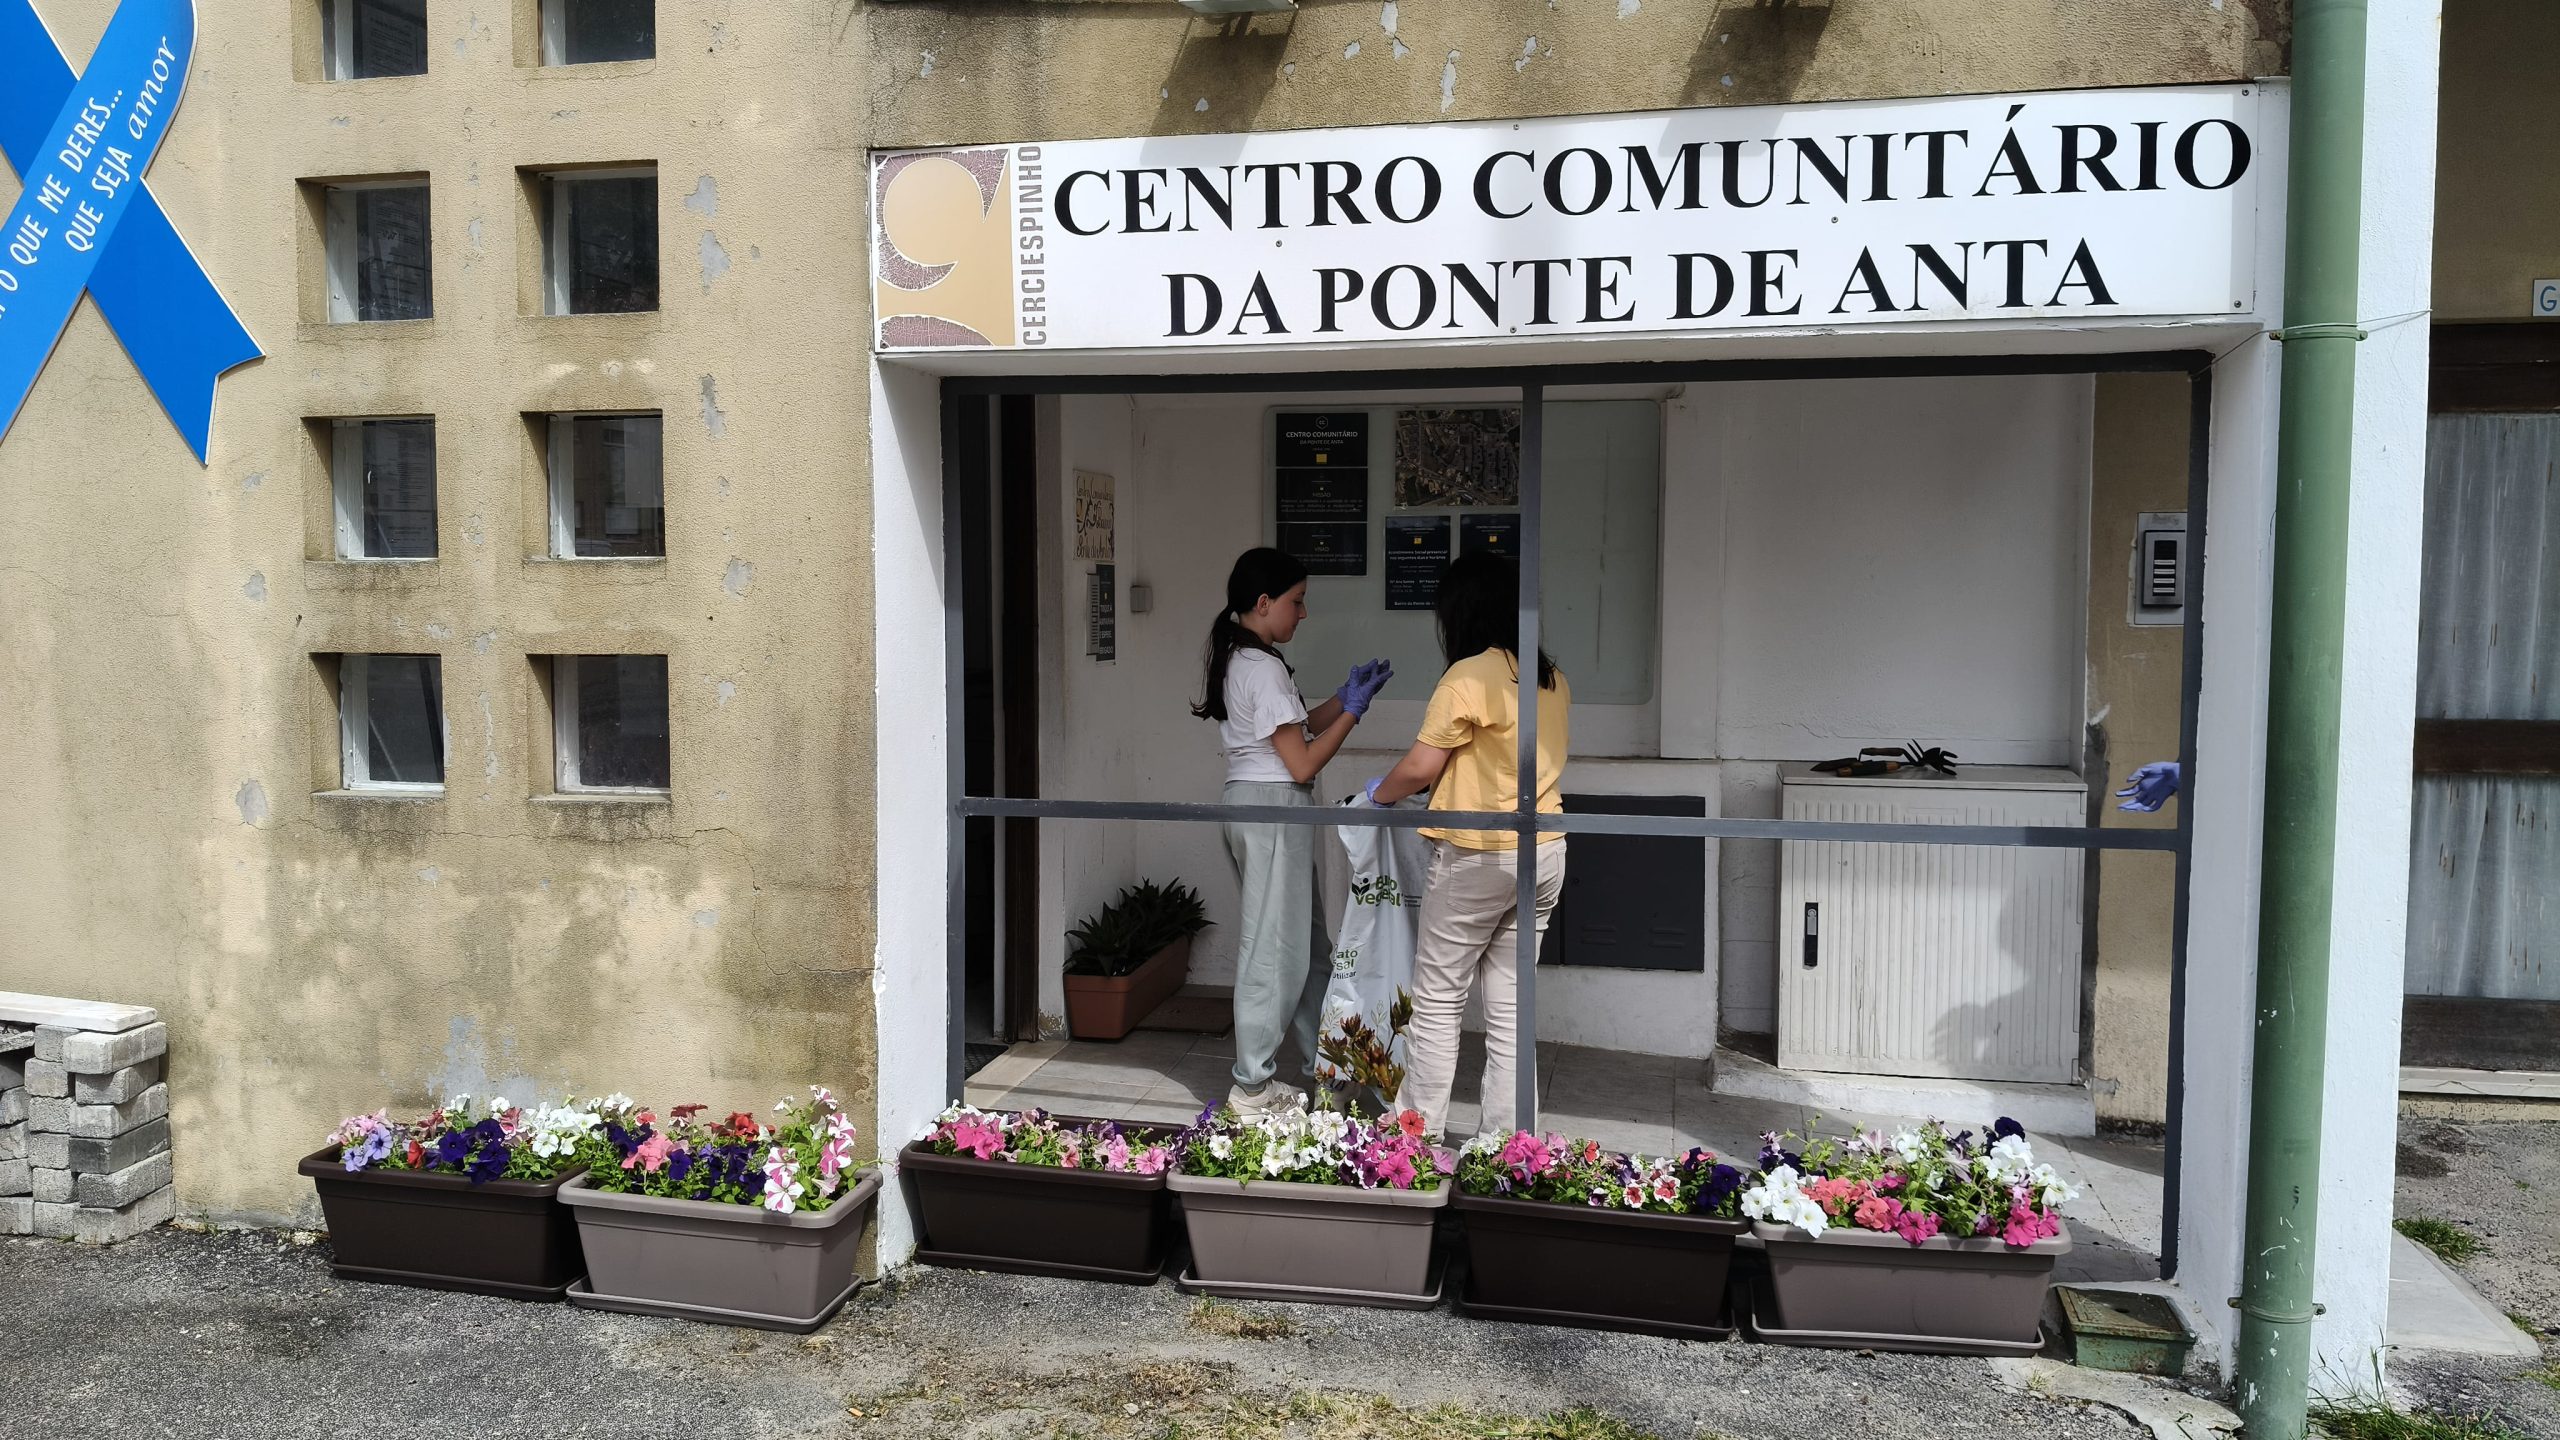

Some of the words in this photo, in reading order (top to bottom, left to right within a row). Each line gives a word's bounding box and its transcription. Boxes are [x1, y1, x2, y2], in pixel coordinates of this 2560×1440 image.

[9, 213, 49, 266] QUE
[36, 173, 71, 215] ME
[58, 89, 123, 173] DERES...
[64, 199, 104, 252] QUE
[91, 146, 133, 199] SEJA
[128, 35, 176, 140] amor
[1053, 156, 1443, 237] CENTRO
[1472, 104, 2253, 220] COMUNITÁRIO
[1017, 145, 1047, 346] CERCIESPINHO
[1161, 269, 1290, 337] DA
[1312, 256, 1636, 333] PONTE
[1666, 249, 1803, 320] DE
[1828, 237, 2119, 314] ANTA
[1335, 959, 1355, 971] sal
[1336, 949, 1358, 959] ato
